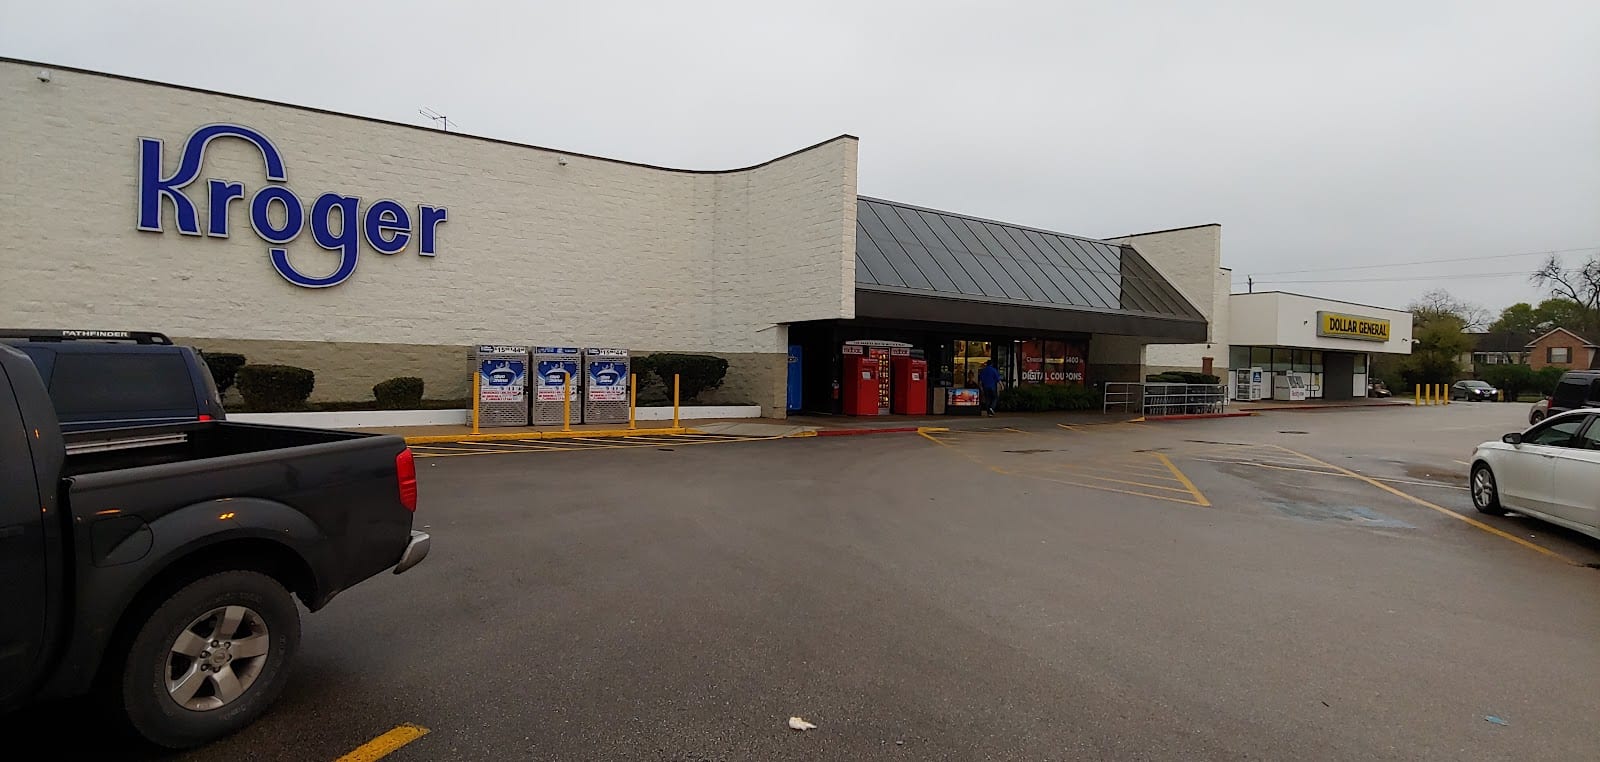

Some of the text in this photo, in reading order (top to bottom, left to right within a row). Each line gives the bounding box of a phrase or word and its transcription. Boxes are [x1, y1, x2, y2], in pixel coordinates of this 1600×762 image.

[137, 122, 448, 288] Kroger
[1329, 318, 1387, 336] DOLLAR GENERAL
[1021, 371, 1050, 381] DIGITAL
